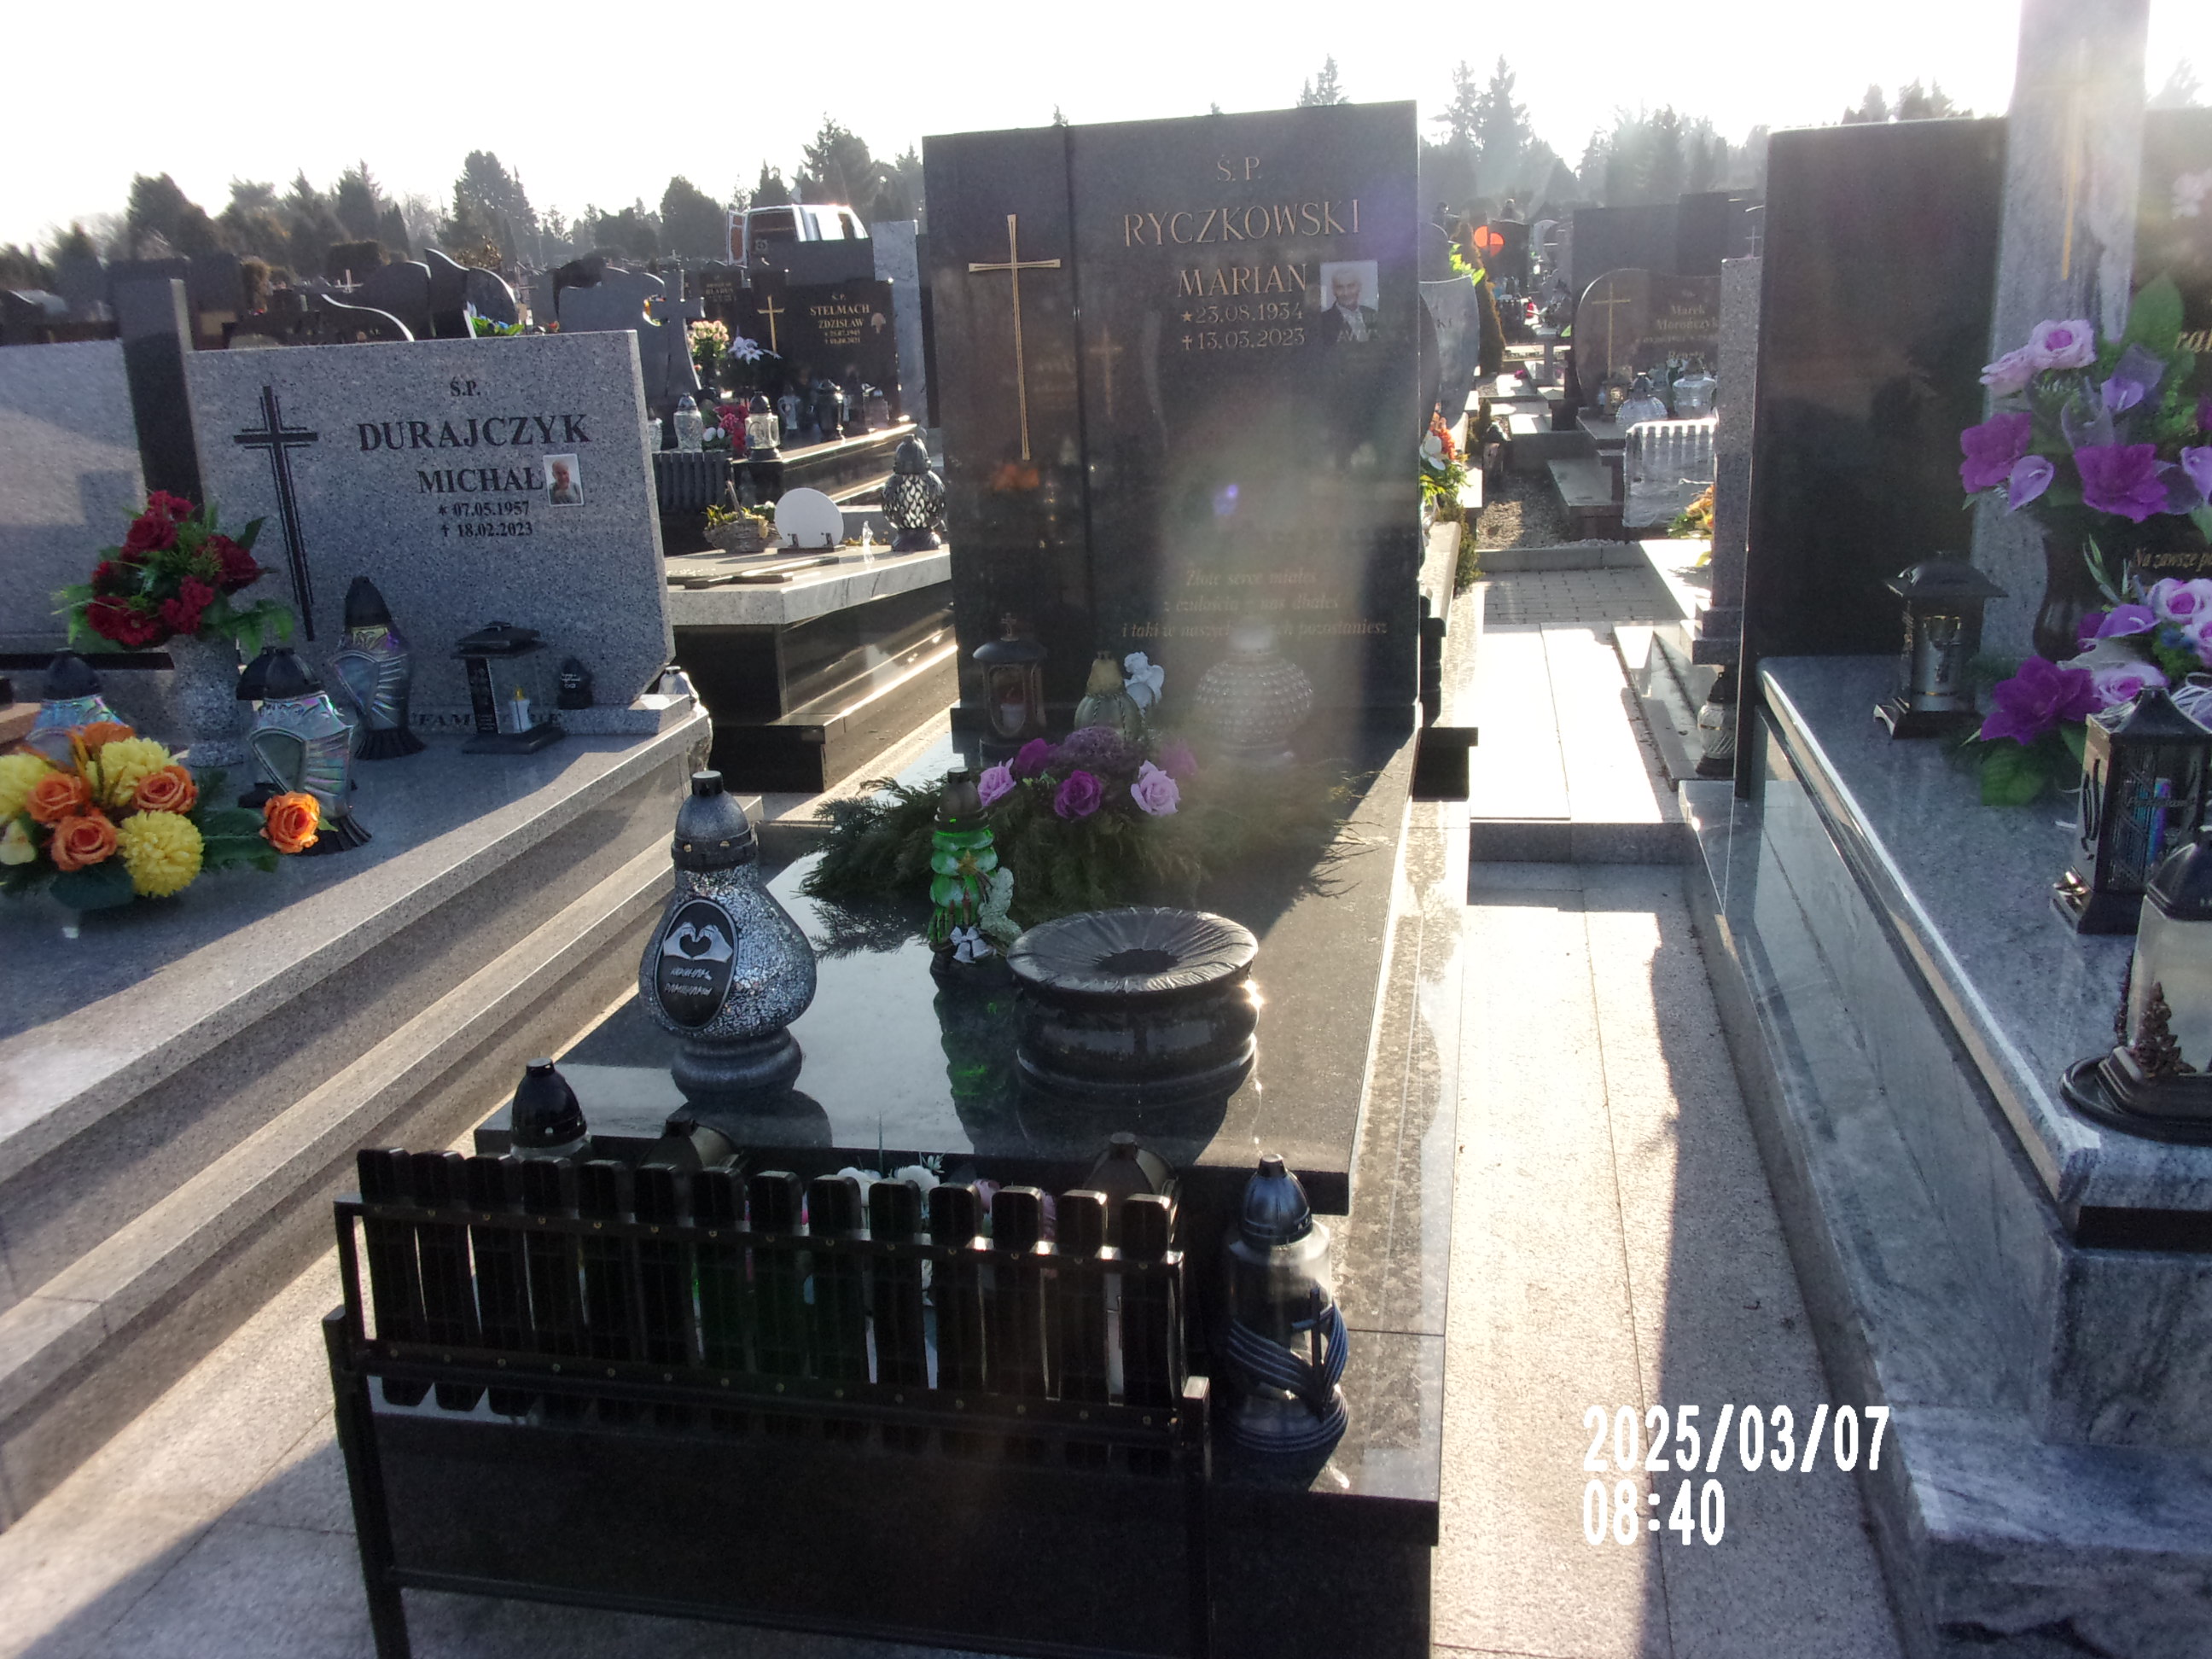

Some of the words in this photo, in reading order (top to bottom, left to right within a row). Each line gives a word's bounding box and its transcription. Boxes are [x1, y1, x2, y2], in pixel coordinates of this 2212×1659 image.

[1123, 199, 1359, 247] RYCZKOWSKI
[1177, 264, 1307, 298] MARIAN
[809, 304, 870, 316] STELMACH
[1671, 304, 1705, 315] Marek
[357, 414, 591, 451] DURAJCZYK
[416, 467, 544, 494] MICHAŁ
[452, 501, 530, 517] 07.05.1957
[457, 521, 533, 538] 18.02.2023
